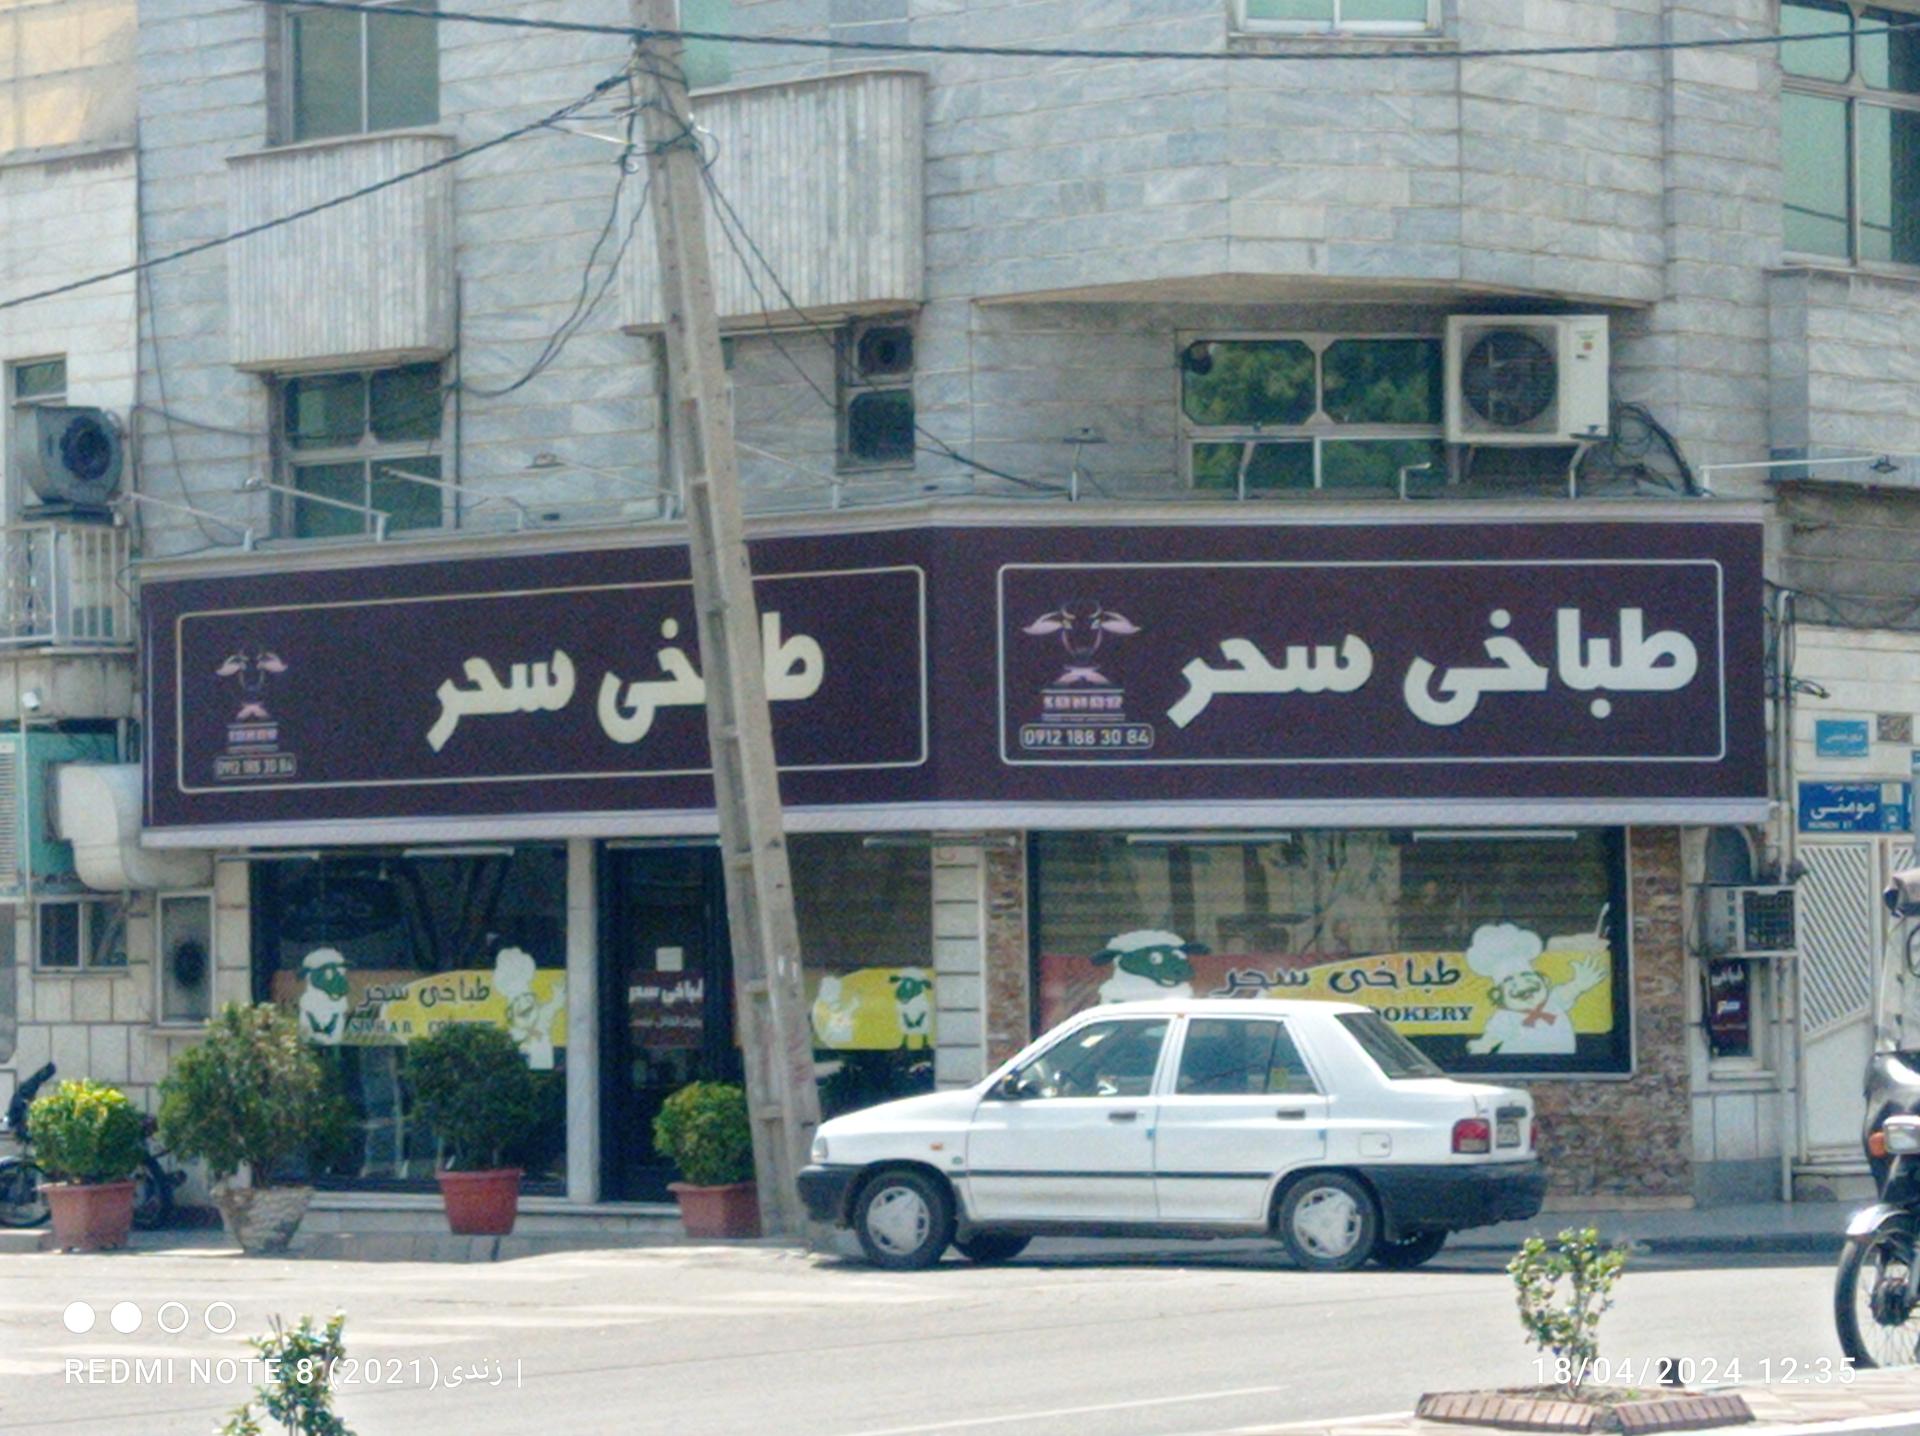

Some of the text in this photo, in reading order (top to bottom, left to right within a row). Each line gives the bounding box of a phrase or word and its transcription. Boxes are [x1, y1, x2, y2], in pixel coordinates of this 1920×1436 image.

[426, 613, 824, 751] طخی سحر
[1166, 607, 1698, 728] طباخی سحر
[1024, 729, 1062, 745] 0912
[1101, 729, 1121, 744] 30
[1217, 957, 1461, 997] طباخی سحر
[1368, 1005, 1473, 1021] OKERY
